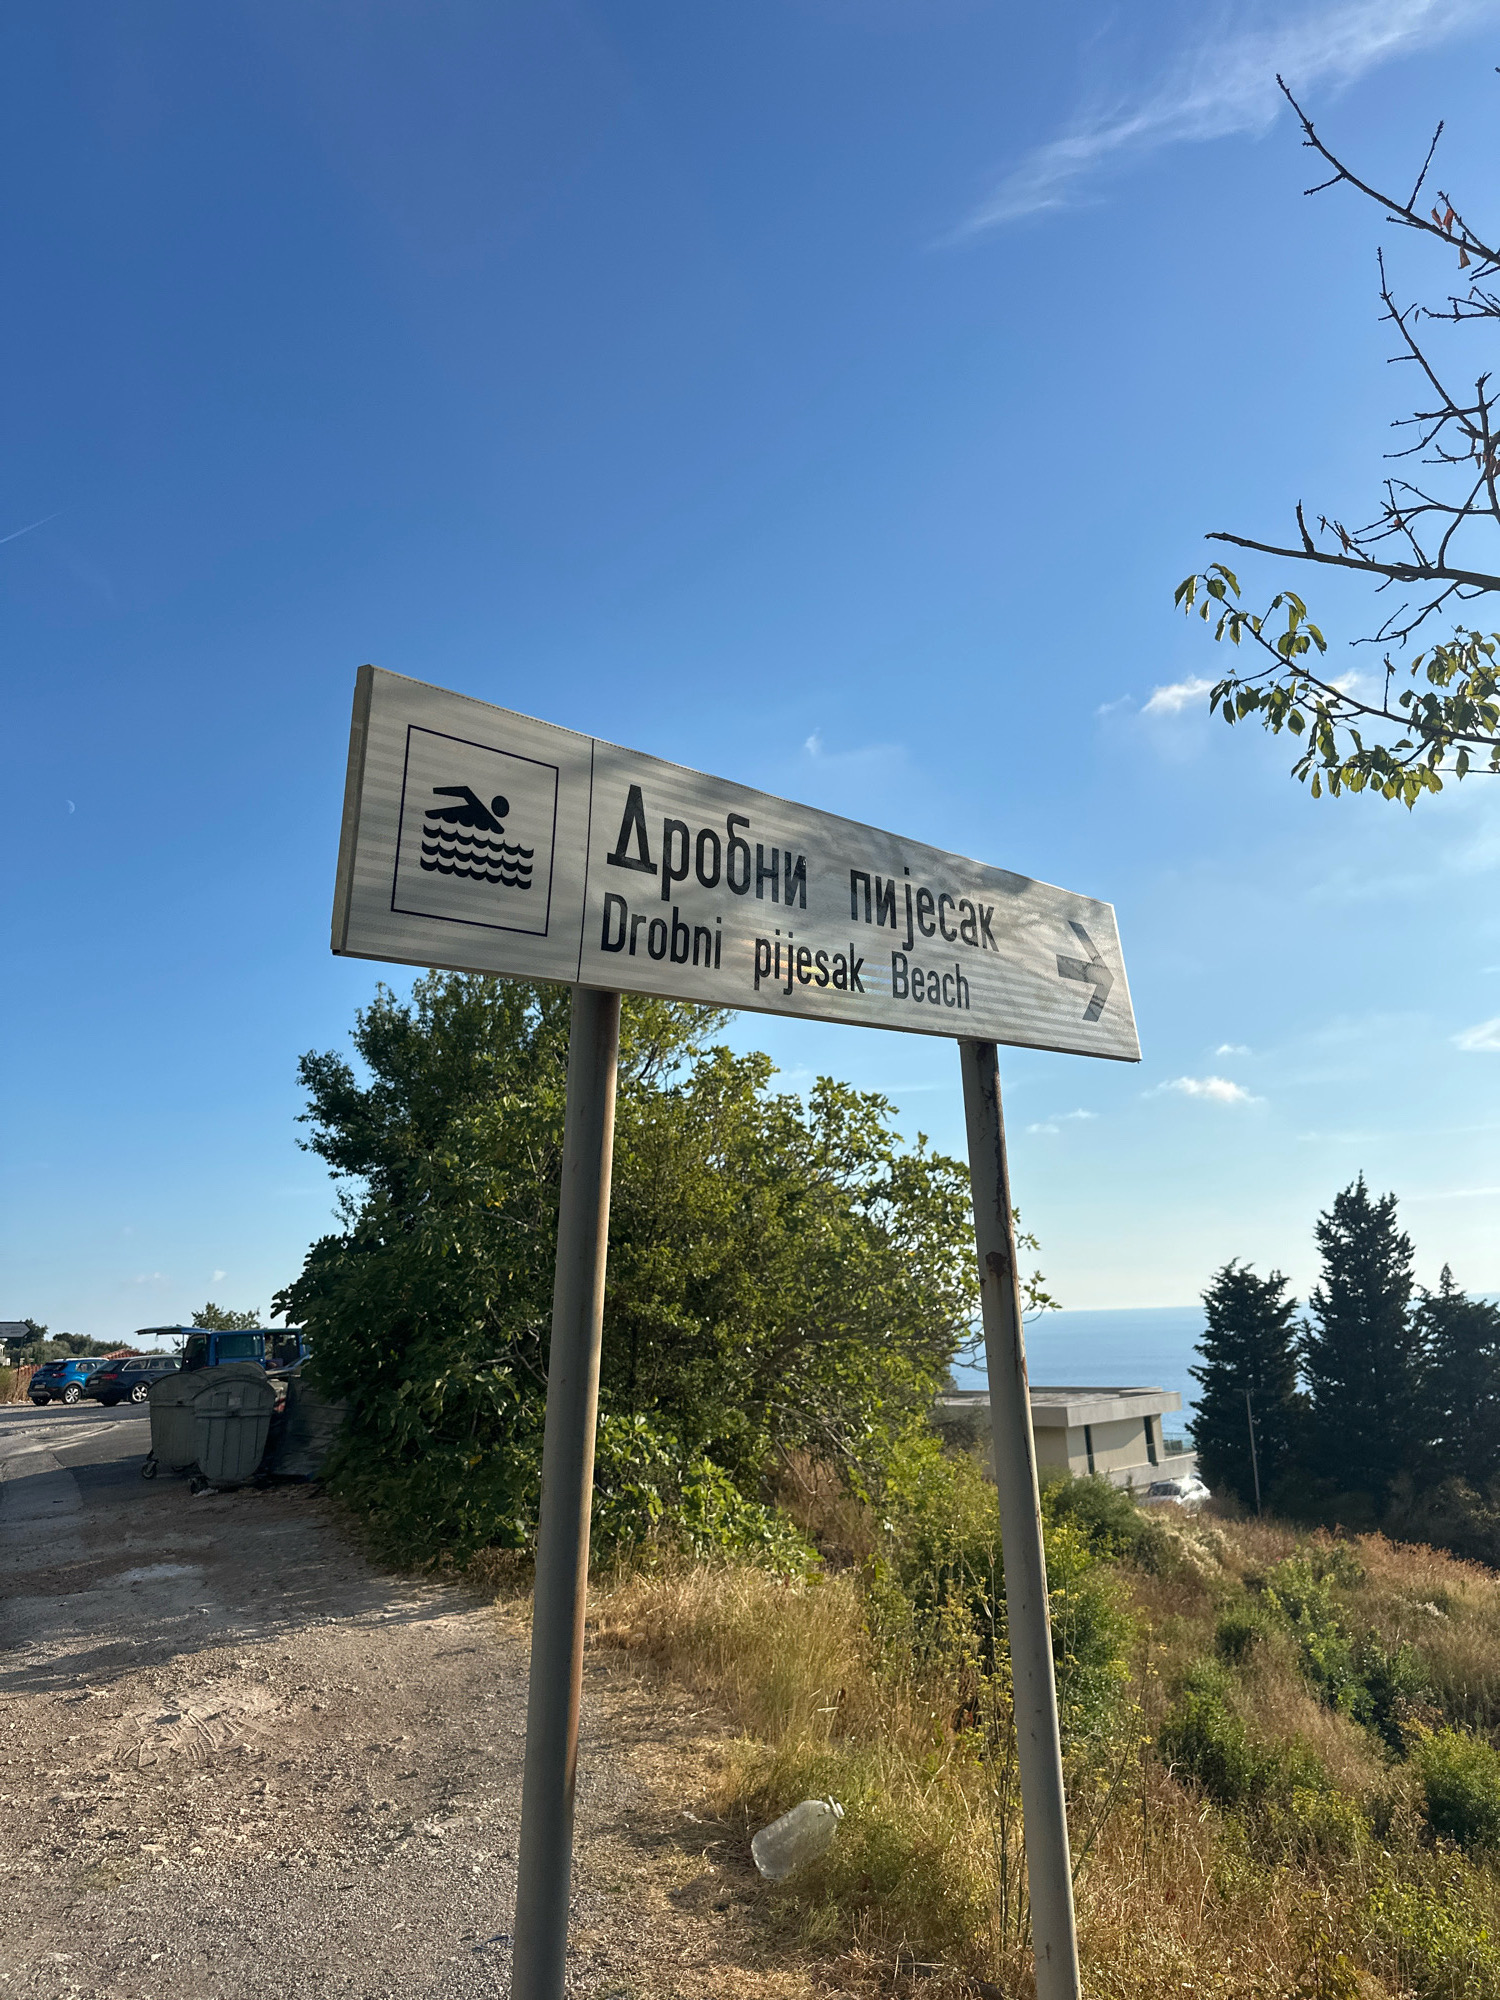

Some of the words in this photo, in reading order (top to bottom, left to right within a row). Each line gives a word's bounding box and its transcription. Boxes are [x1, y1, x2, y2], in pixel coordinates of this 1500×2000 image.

[607, 785, 807, 909] Дробни
[850, 867, 999, 952] пијесак
[601, 892, 722, 969] Drobni
[754, 929, 865, 995] pijesak
[891, 951, 970, 1009] Beach
